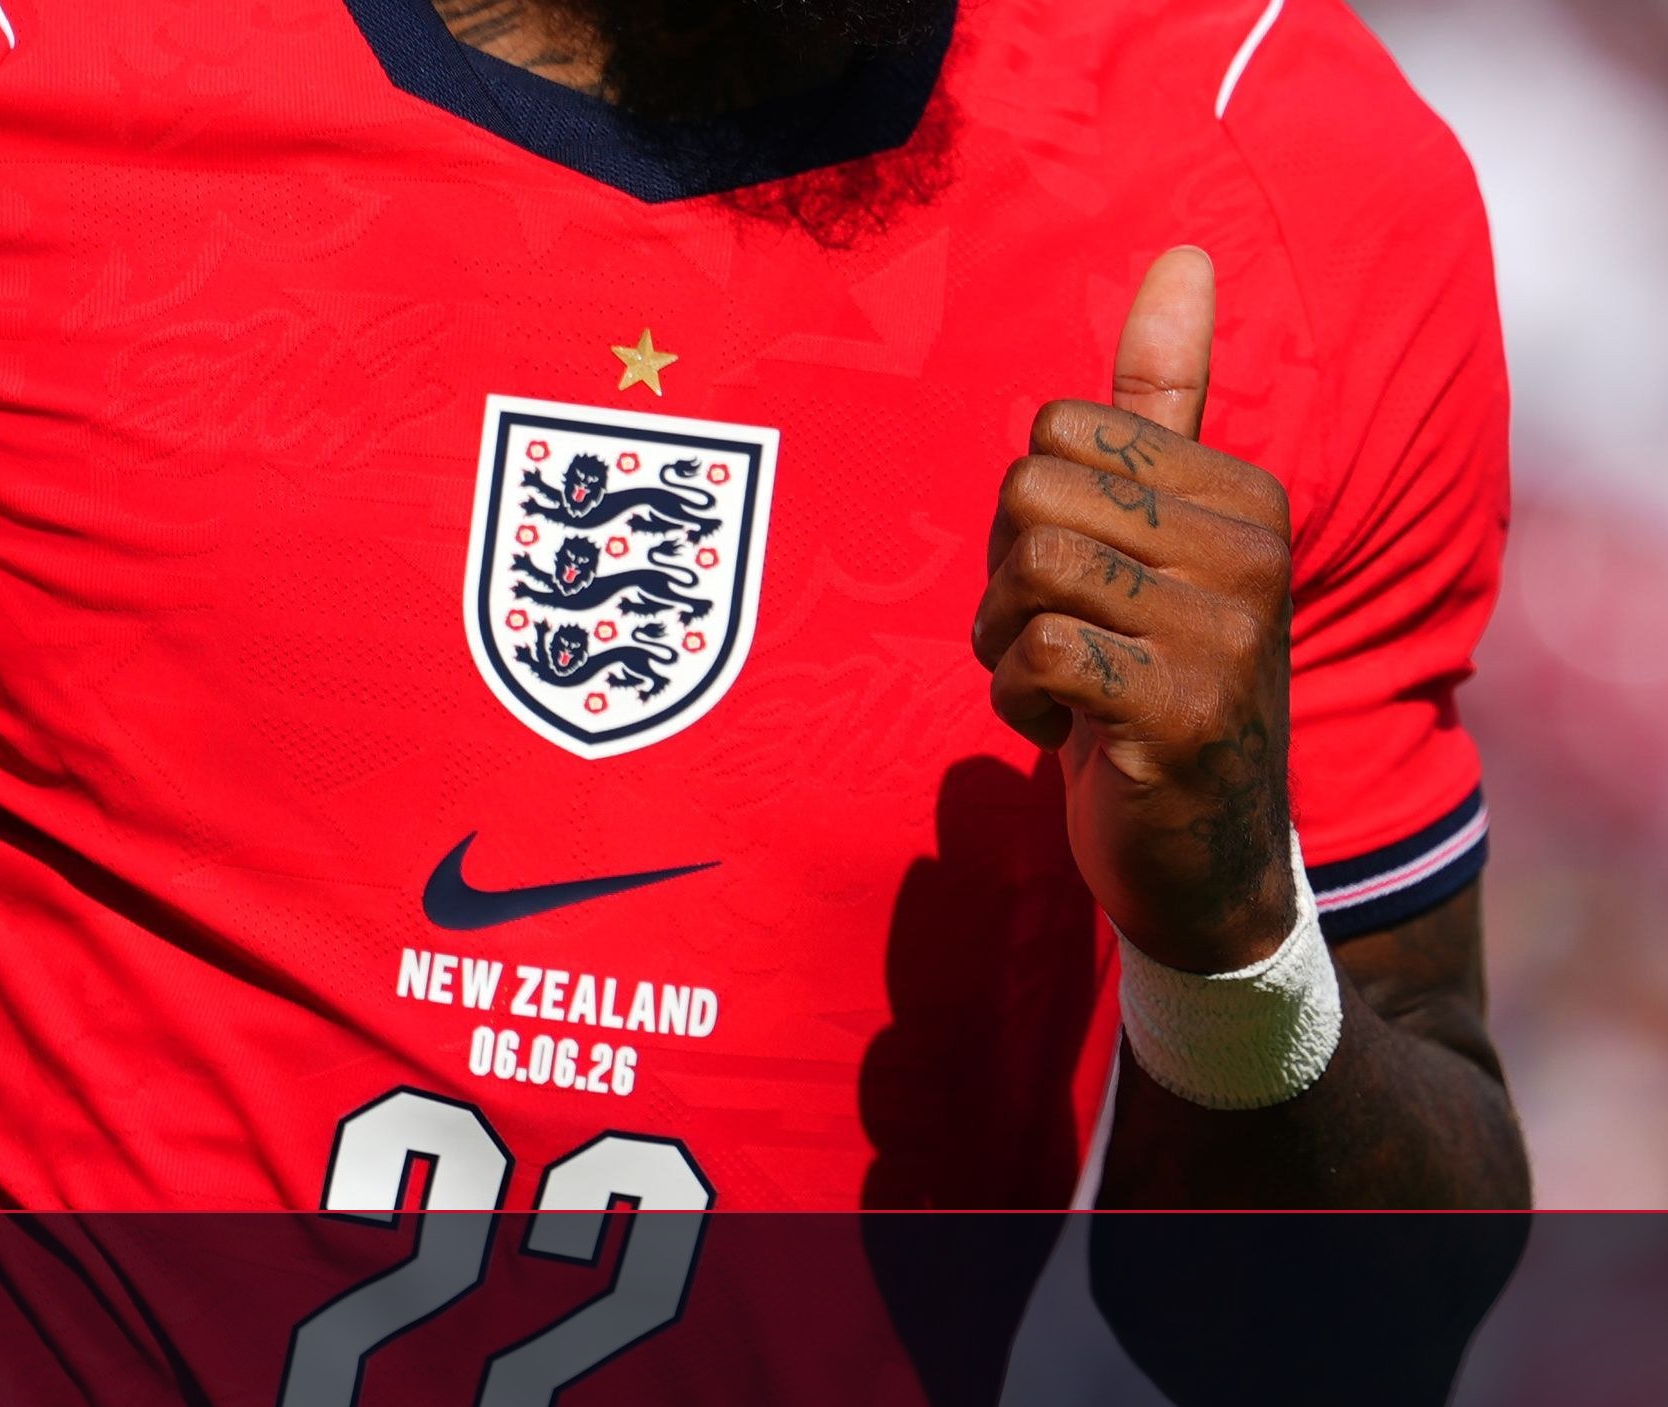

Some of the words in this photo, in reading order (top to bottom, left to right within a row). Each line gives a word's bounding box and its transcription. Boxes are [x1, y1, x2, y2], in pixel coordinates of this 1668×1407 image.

[396, 947, 504, 1011] NEW
[509, 964, 718, 1038] ZEALAND
[468, 1025, 638, 1097] 06.06.26
[278, 1085, 717, 1407] 22
